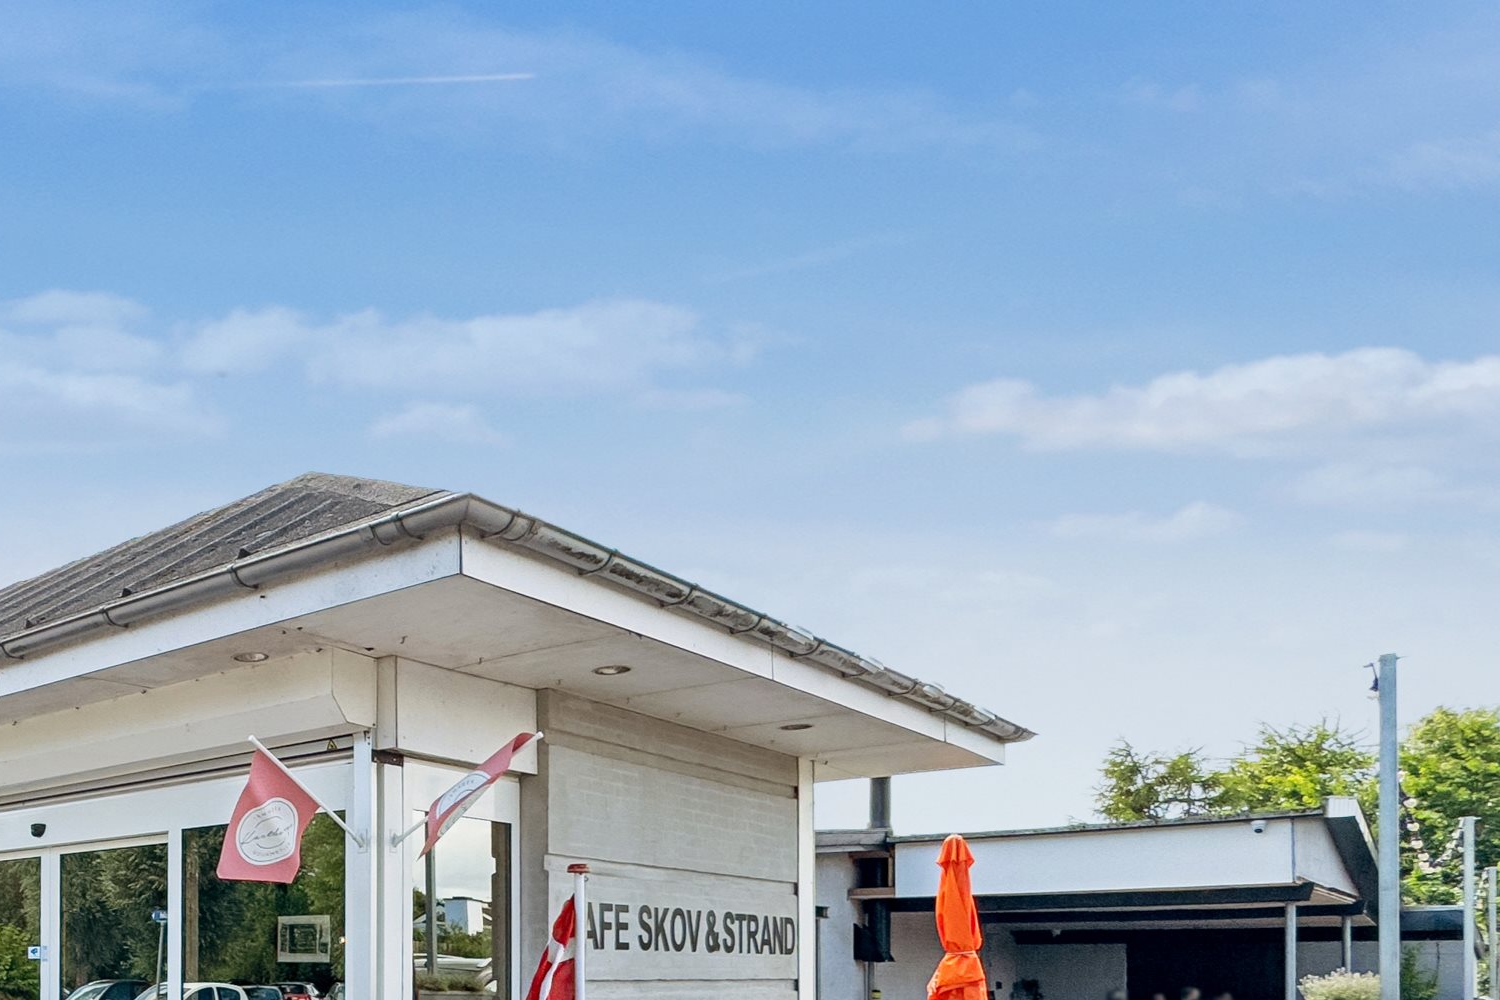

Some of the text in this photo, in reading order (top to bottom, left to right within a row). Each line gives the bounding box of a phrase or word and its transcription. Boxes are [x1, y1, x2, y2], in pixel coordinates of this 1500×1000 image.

[586, 901, 630, 951] AFE
[637, 904, 702, 953] SKOV
[722, 911, 795, 956] STRAND
